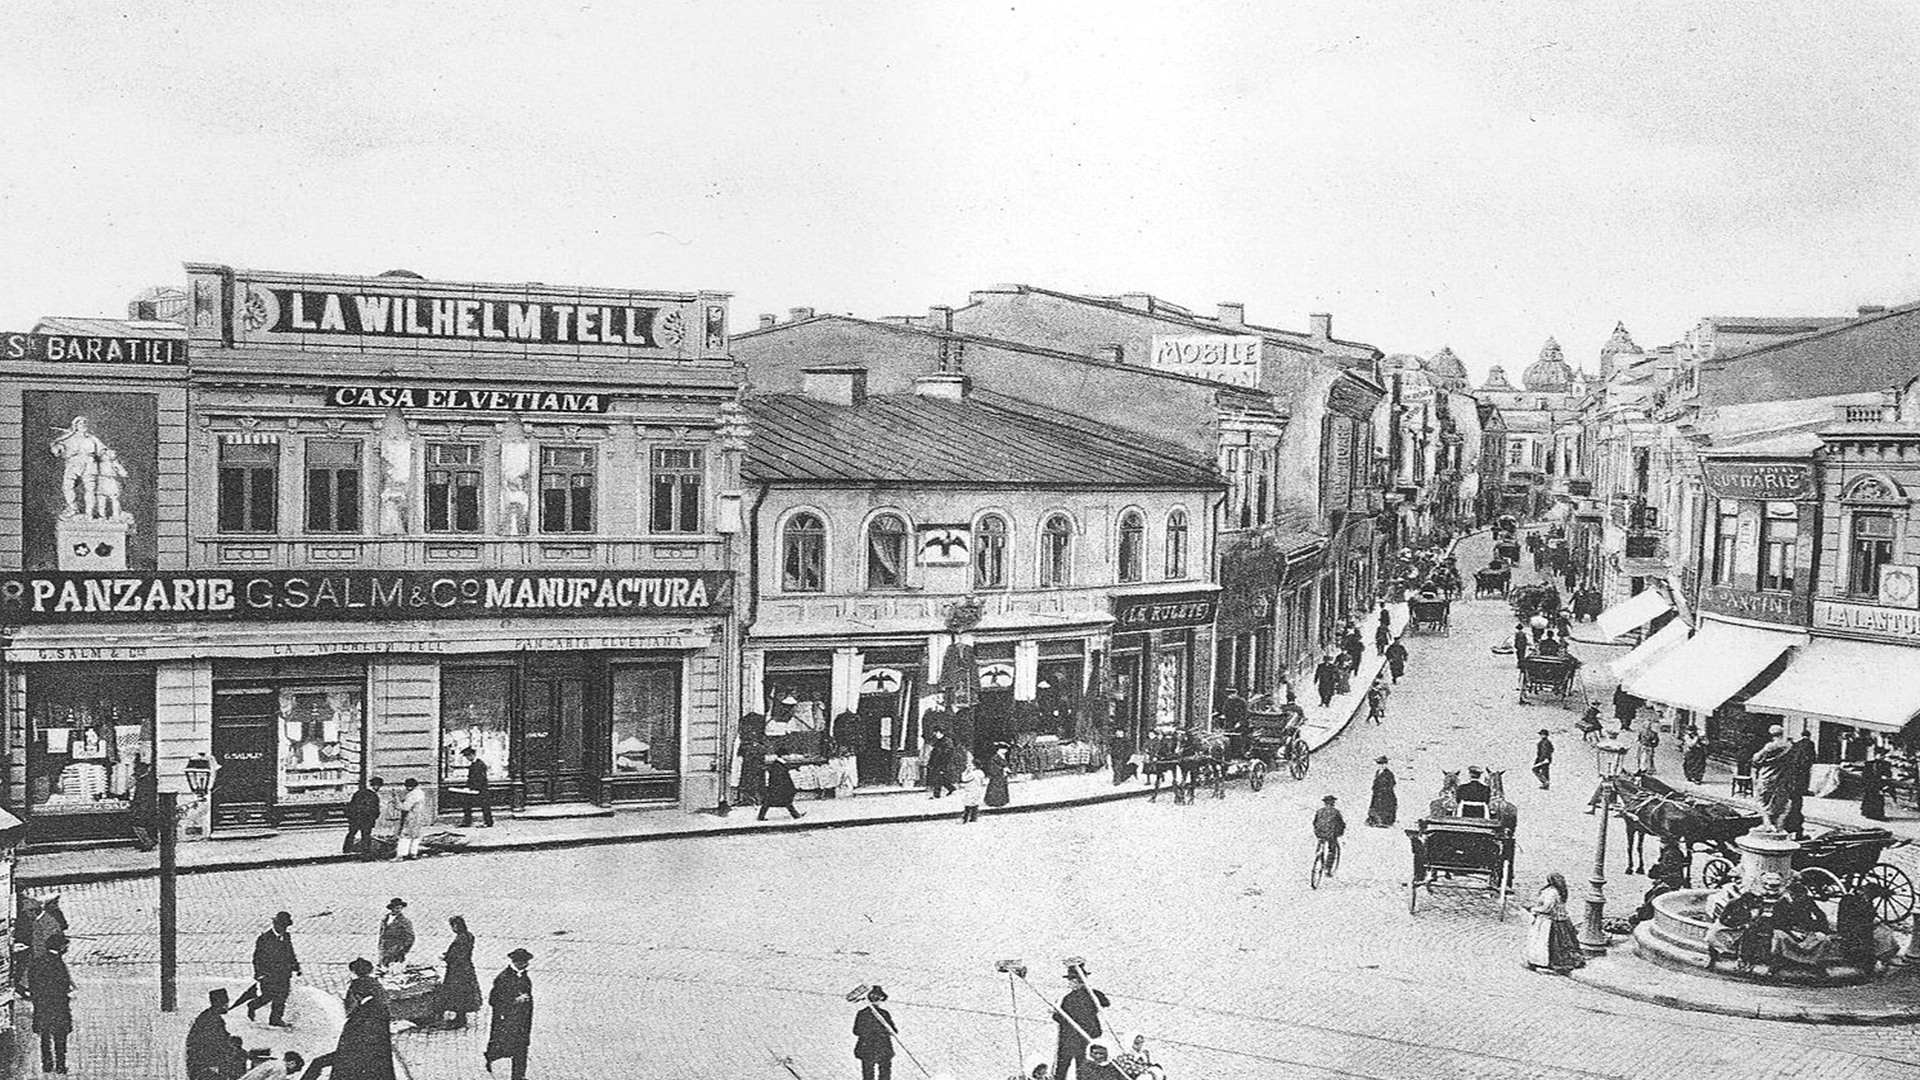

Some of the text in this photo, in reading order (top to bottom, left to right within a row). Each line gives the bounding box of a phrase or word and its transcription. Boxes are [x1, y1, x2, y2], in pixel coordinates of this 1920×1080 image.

[292, 292, 647, 345] LA WILHELM TELL
[47, 336, 173, 364] BARATIEI
[1157, 341, 1257, 365] MOBILE
[335, 387, 600, 412] CASA ELVETIANA
[31, 578, 236, 612] PANZARIE
[483, 577, 711, 609] MANUFACTURA
